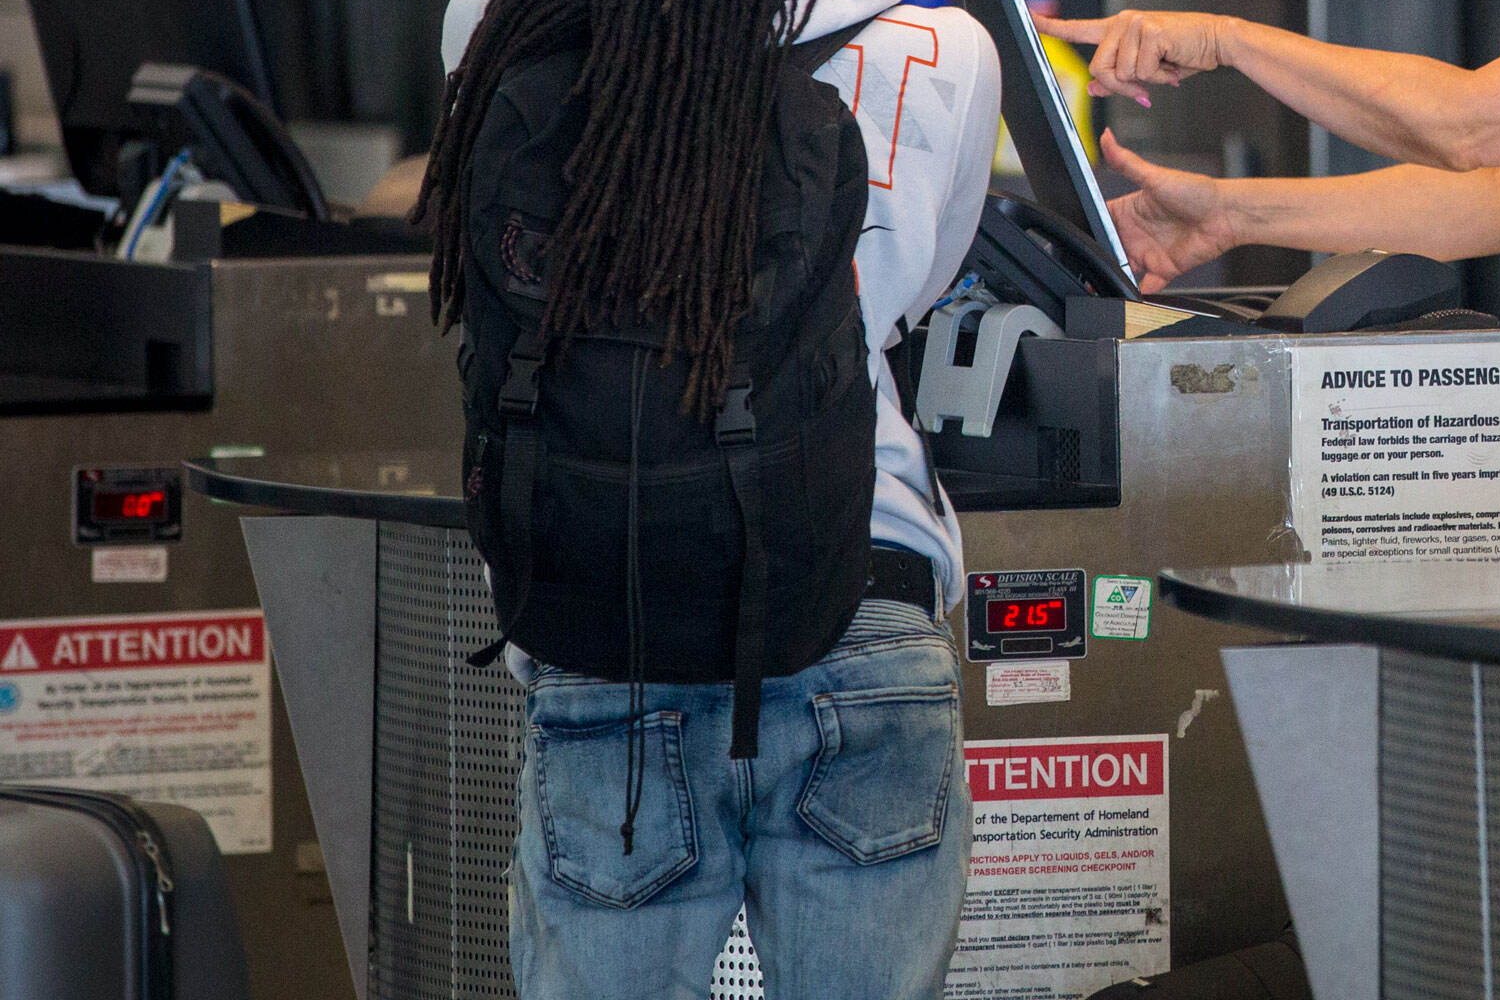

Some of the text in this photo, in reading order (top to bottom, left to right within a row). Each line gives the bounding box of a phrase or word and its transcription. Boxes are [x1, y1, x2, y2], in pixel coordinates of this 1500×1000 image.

[1321, 370, 1386, 389] ADVICE
[1390, 369, 1413, 387] TO
[1321, 416, 1413, 432] Transportation
[1417, 415, 1430, 428] of
[1433, 414, 1500, 428] Hazardous
[1321, 437, 1355, 447] Federal
[1358, 436, 1375, 446] law
[1377, 435, 1410, 445] forbids
[1412, 435, 1427, 444] the
[1429, 434, 1467, 445] carriage
[1469, 433, 1479, 443] of
[1321, 450, 1444, 462] luggage or on your person.
[1321, 473, 1329, 483] A
[1330, 472, 1371, 482] violation
[1372, 473, 1390, 481] can
[1392, 471, 1419, 481] result
[1421, 471, 1430, 480] in
[1432, 470, 1449, 480] five
[1451, 470, 1476, 480] years
[1321, 486, 1395, 498] (49 U.S.C. 5124)
[1322, 514, 1362, 522] Hazardous
[1364, 513, 1400, 521] materials
[1402, 512, 1430, 520] include
[1432, 511, 1474, 521] explosives,
[1322, 527, 1354, 536] poisons,
[1356, 525, 1396, 534] corrosives
[1397, 524, 1412, 532] and
[1413, 523, 1456, 532] radioactive
[1458, 522, 1496, 531] materials.
[1322, 537, 1350, 547] Paints,
[1352, 537, 1378, 547] lighter
[1380, 536, 1400, 545] fluid,
[1402, 535, 1442, 544] fireworks,
[1444, 535, 1460, 543] tear
[1462, 535, 1488, 544] gases,
[1322, 550, 1335, 558] are
[1337, 548, 1366, 558] special
[1368, 547, 1414, 557] exceptions
[1415, 547, 1427, 555] for
[1429, 546, 1450, 555] small
[1452, 545, 1492, 554] quantities
[52, 623, 252, 665] ATTENTION
[964, 753, 1148, 791] TTENTION
[975, 808, 1149, 825] of the Departement of Homeland
[973, 825, 1158, 844] ansportation Security Administration
[1012, 854, 1039, 863] APPLY
[1041, 853, 1053, 861] TO
[1055, 852, 1091, 861] LIQUIDS,
[1094, 851, 1120, 860] GELS,
[1121, 850, 1155, 858] AND/OR
[974, 867, 1026, 876] PASSENGER
[1029, 865, 1078, 874] SCREENING
[1081, 863, 1136, 872] CHECKPOINT
[994, 888, 1019, 896] EXCEPT
[960, 913, 986, 921] ubjected
